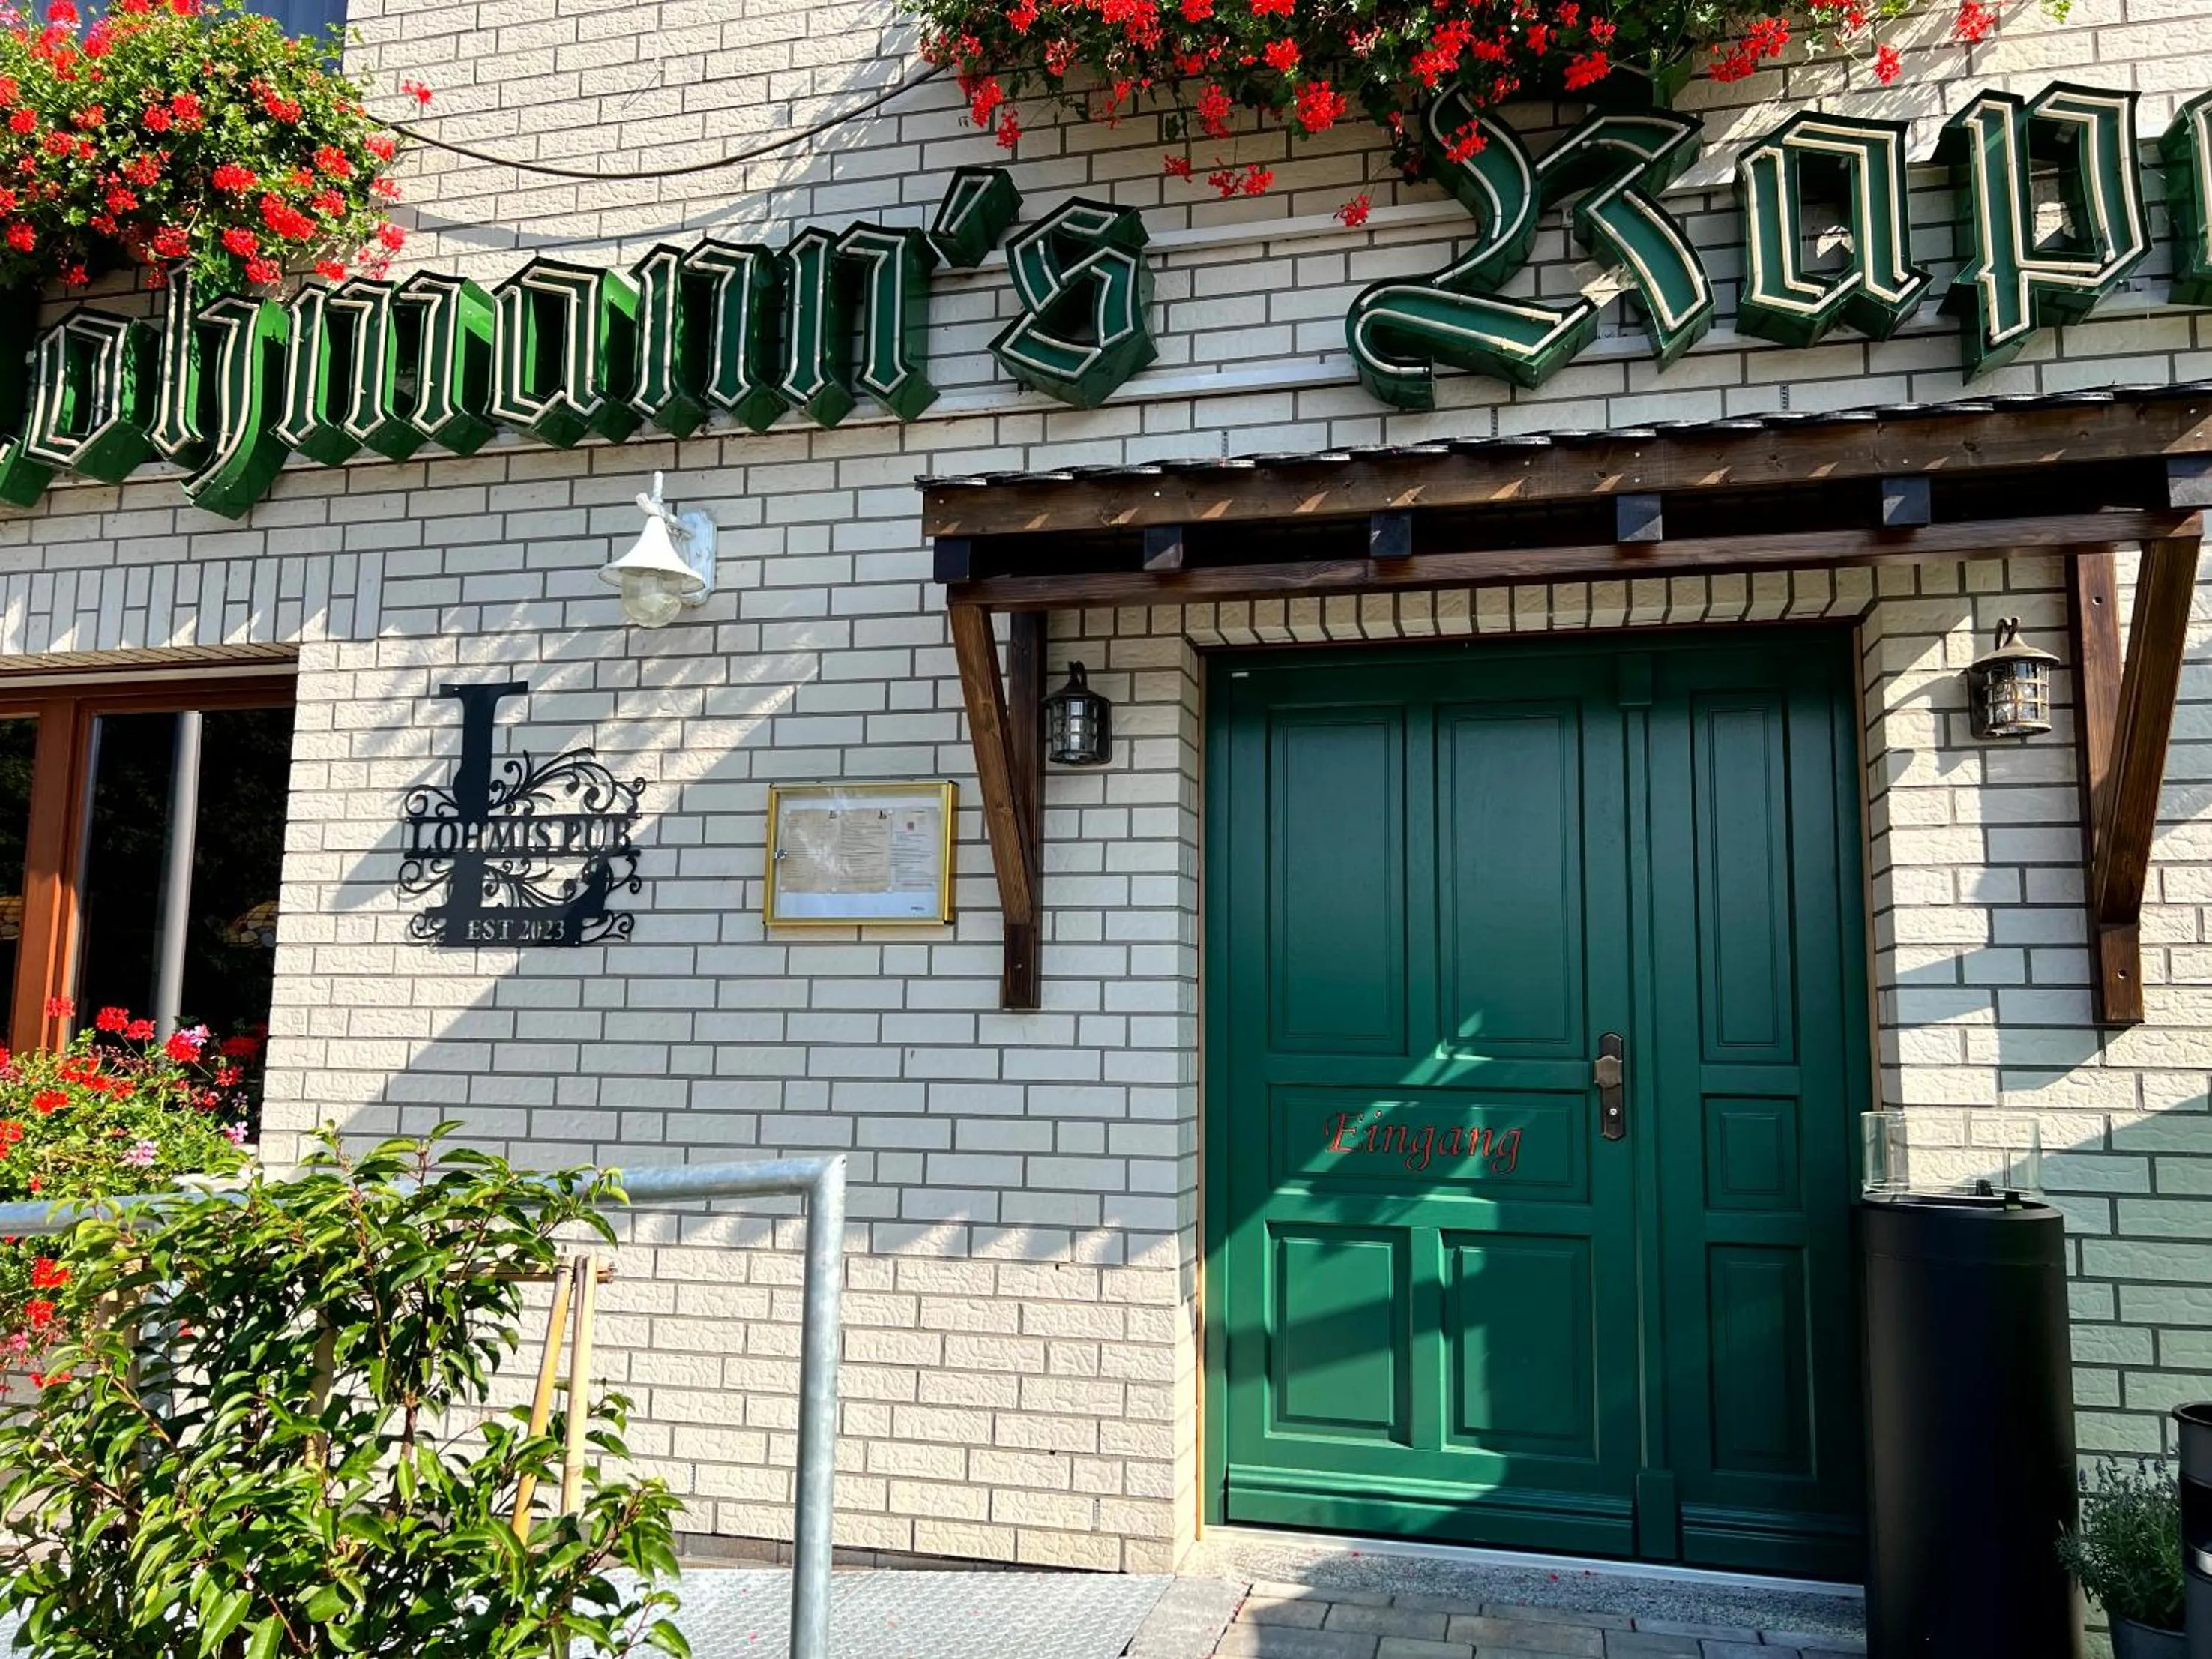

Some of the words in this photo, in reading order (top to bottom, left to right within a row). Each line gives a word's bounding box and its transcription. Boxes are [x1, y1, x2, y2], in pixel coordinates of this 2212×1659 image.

[0, 166, 1158, 520] ohmann's
[465, 918, 513, 941] EST
[517, 918, 566, 941] 2023
[1323, 1111, 1522, 1174] Eingang
